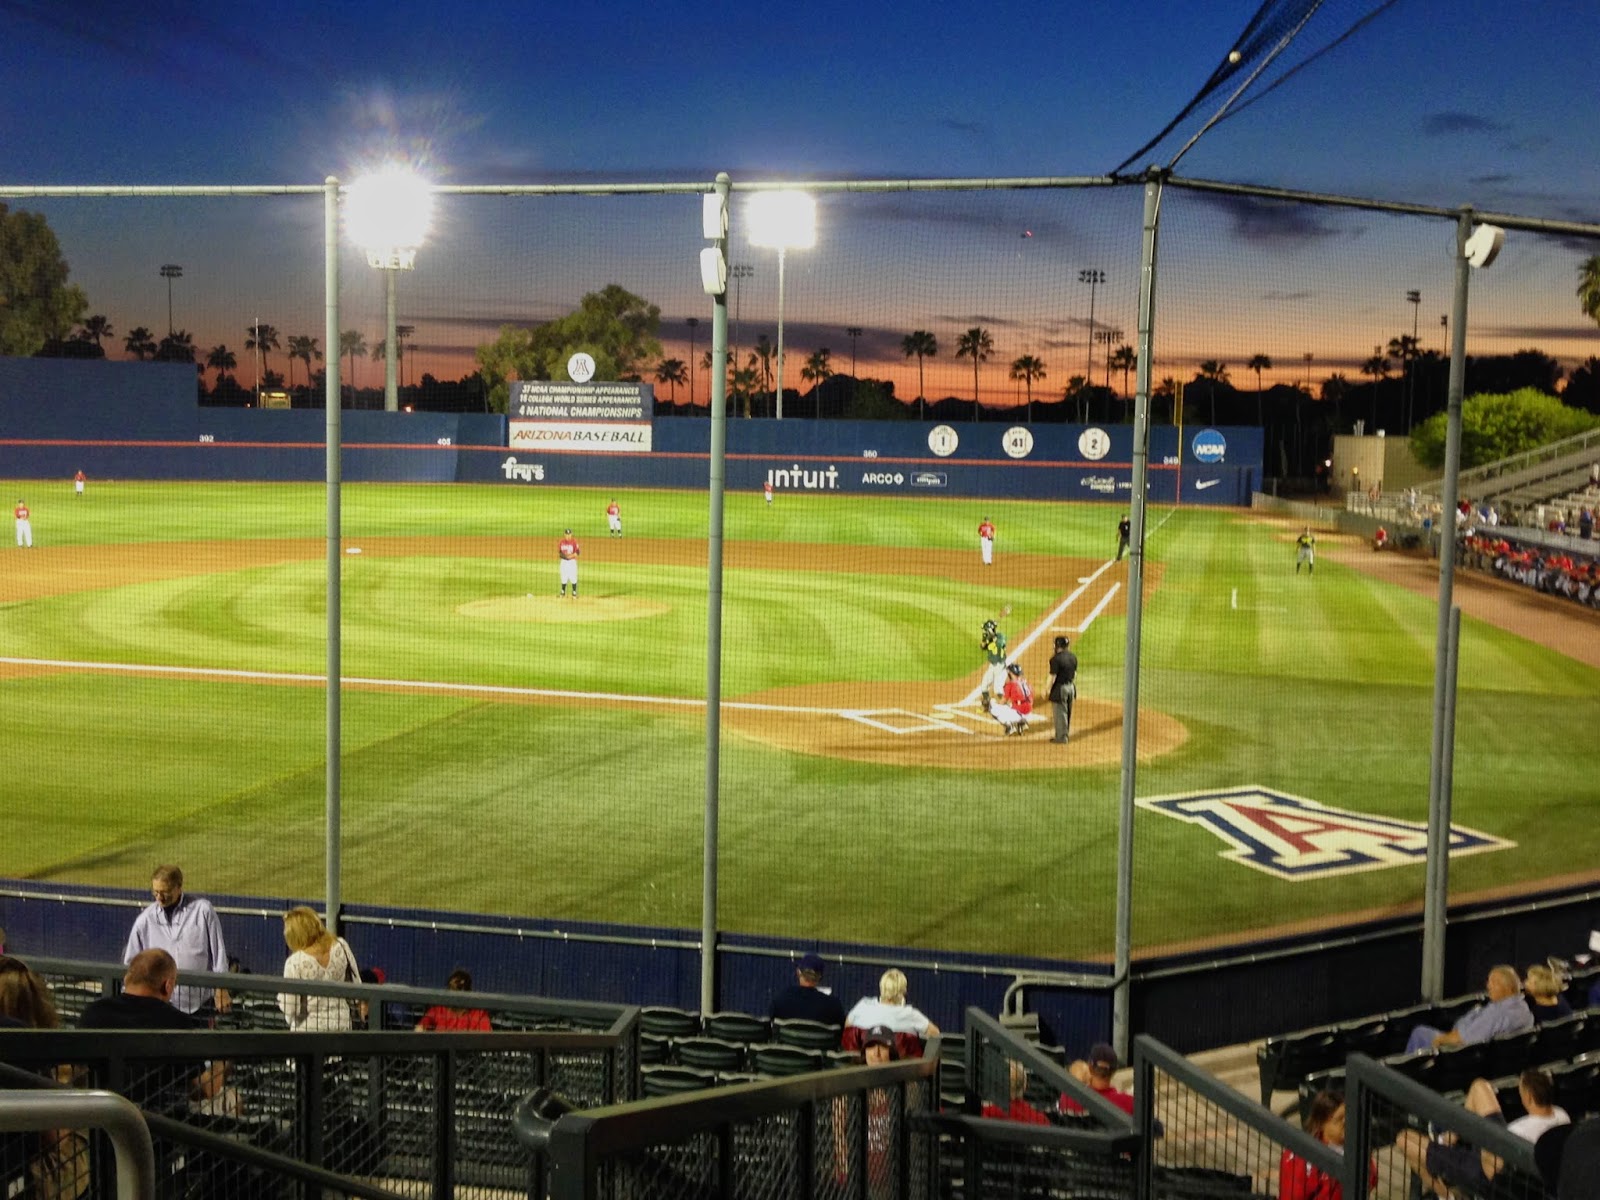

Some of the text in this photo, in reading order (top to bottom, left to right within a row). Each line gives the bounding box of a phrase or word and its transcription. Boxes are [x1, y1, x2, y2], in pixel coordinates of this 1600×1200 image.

[531, 385, 548, 393] NCAA
[549, 385, 595, 394] CHAMPIONSHIP
[596, 386, 639, 395] APPEARANCES
[528, 395, 553, 403] COLLEGE
[554, 395, 575, 403] WORLD
[576, 395, 597, 404] SERIES
[597, 396, 641, 404] APPEARANCES
[519, 406, 643, 418] 4 NATIONAL CHAMPIONSHIPS
[513, 429, 645, 443] ARIZONA BASEBALL
[1011, 437, 1024, 448] 41
[1091, 438, 1098, 450] 2
[502, 456, 545, 482] fry's
[767, 464, 839, 489] intuit
[861, 472, 893, 485] ARCO
